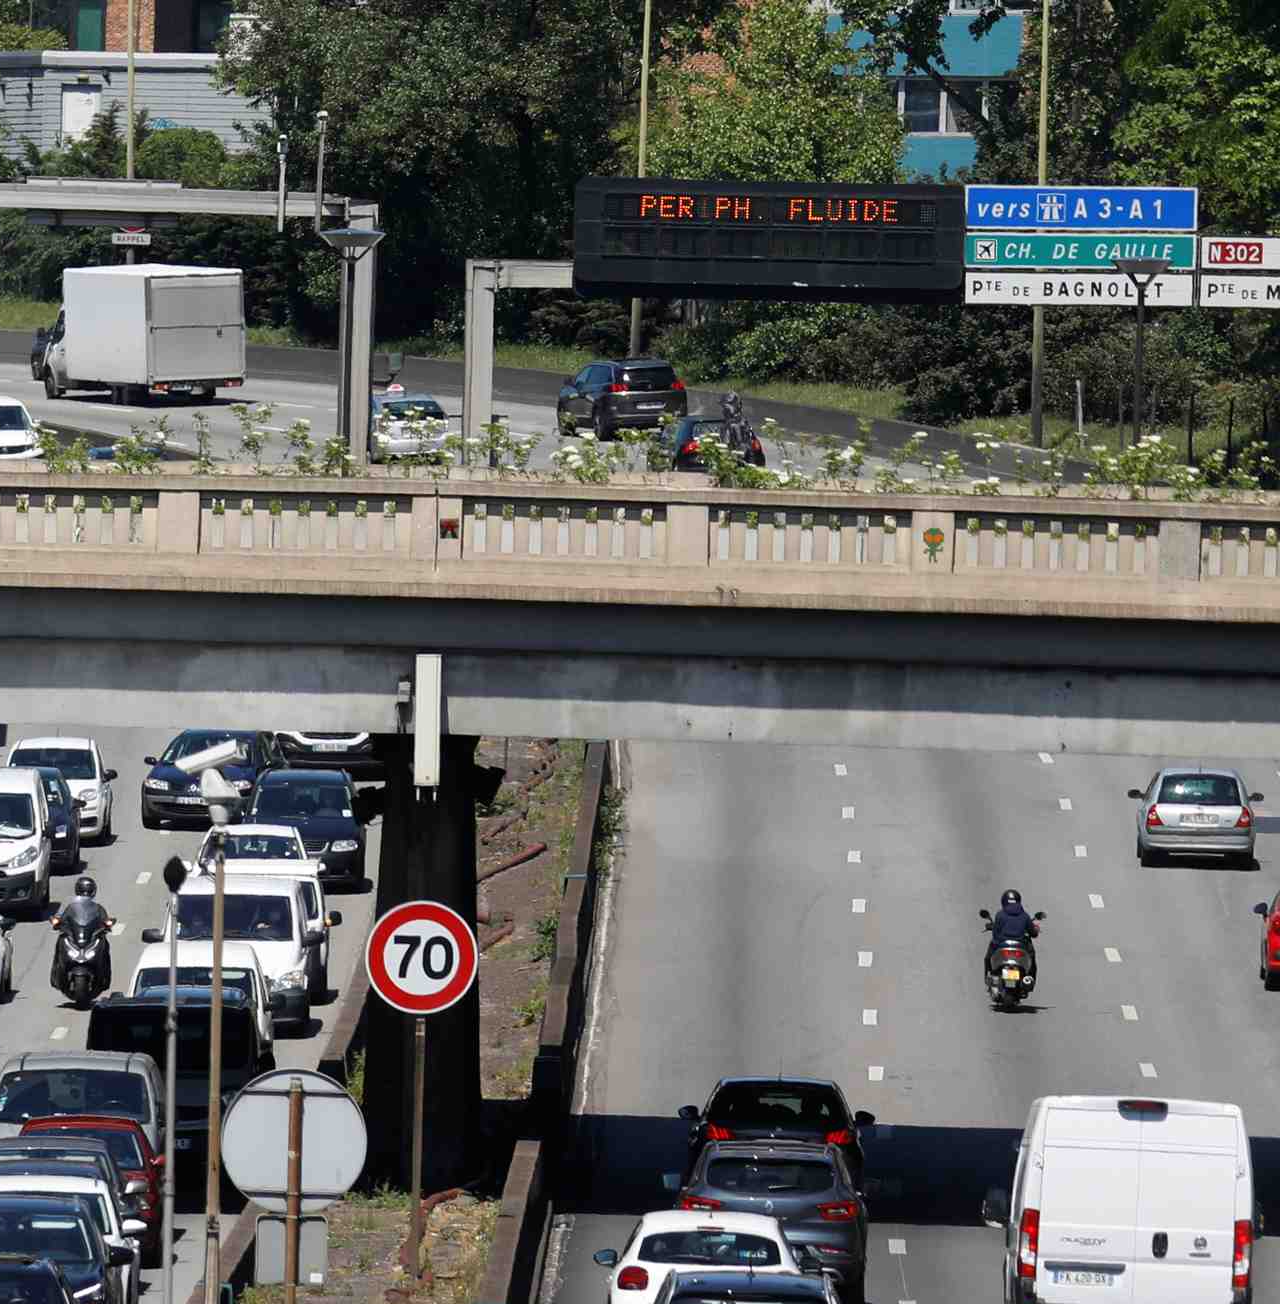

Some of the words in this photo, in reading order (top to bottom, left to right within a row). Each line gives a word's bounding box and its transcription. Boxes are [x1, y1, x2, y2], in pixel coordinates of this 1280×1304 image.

[789, 199, 898, 223] FLUIDE
[977, 202, 1030, 218] vers
[1004, 242, 1036, 259] CH.
[1052, 242, 1079, 259] DE
[1012, 286, 1030, 297] DE
[1241, 289, 1258, 300] DE
[393, 935, 454, 980] 70
